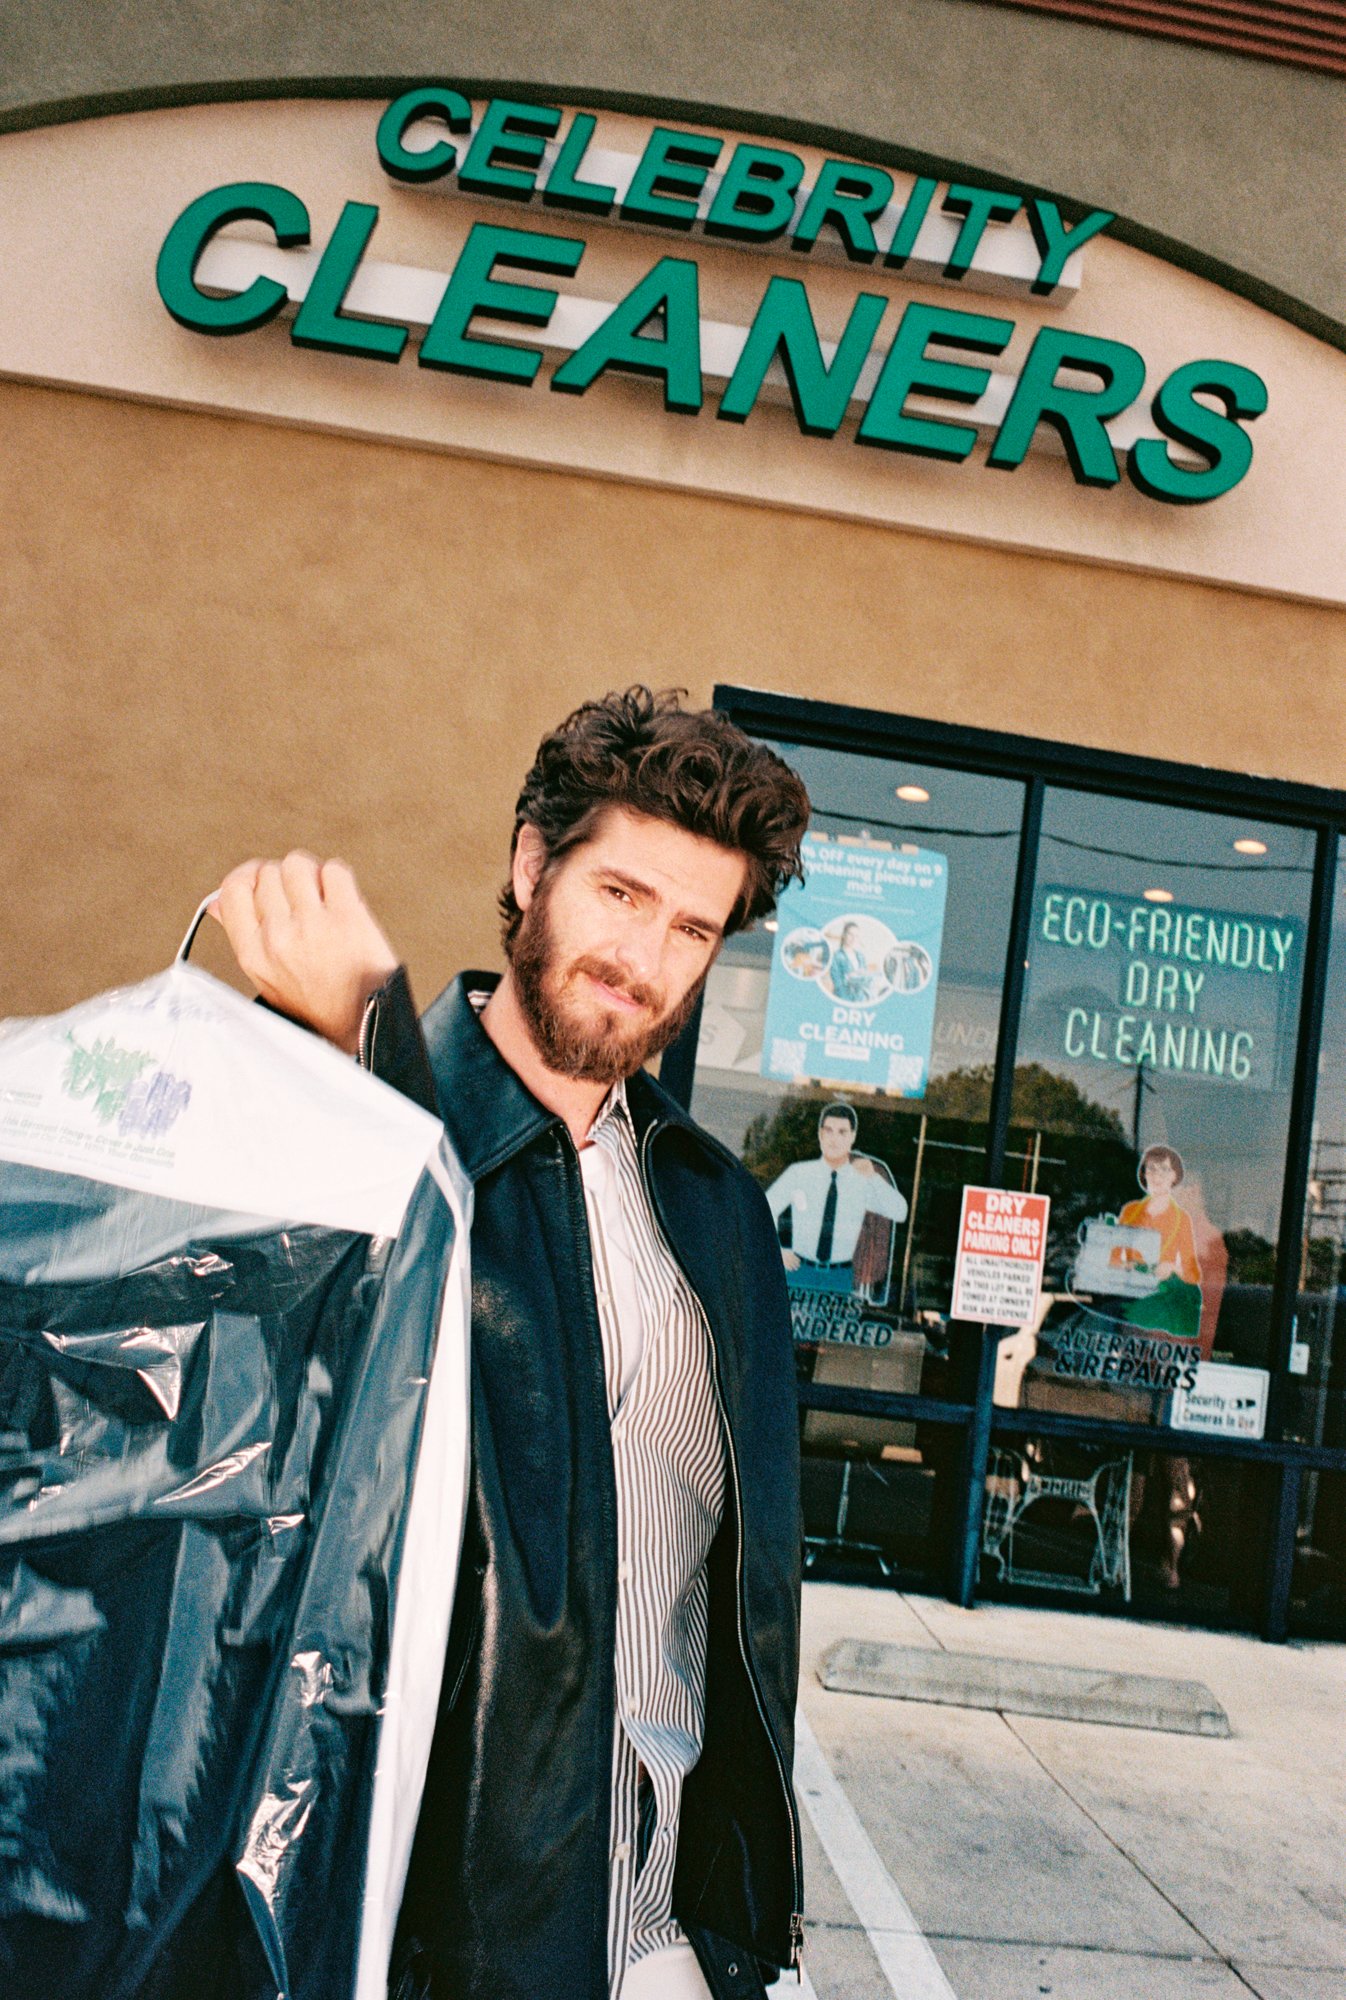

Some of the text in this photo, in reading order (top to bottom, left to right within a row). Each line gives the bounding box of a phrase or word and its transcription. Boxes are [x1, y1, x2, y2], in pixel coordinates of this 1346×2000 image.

[376, 87, 1116, 296] CELEBRITY
[156, 181, 1269, 505] CLEANERS
[819, 848, 844, 861] OFF
[847, 854, 883, 870] every
[887, 857, 911, 873] day
[914, 864, 930, 875] on
[847, 880, 882, 894] more
[1043, 894, 1293, 972] ECO-FRIENDLY
[1126, 961, 1204, 1013] DRY
[832, 1006, 877, 1027] DRY
[800, 1022, 904, 1051] CLEANING
[1065, 1008, 1253, 1080] CLEANING
[986, 1193, 1027, 1216] DRY
[967, 1210, 1040, 1238] CLEANERS
[964, 1229, 1040, 1257] PARKING ONLY
[967, 1268, 1031, 1283] VEHICLES PARKED
[980, 1257, 1035, 1272] UNAUTHORIZED
[961, 1279, 971, 1288] ON
[974, 1280, 989, 1290] THIS
[991, 1282, 1004, 1292] LOT
[1007, 1285, 1022, 1295] WILL
[962, 1291, 987, 1301] TOWED
[989, 1294, 997, 1303] AT
[791, 1289, 862, 1318] HIRTS
[981, 1306, 994, 1316] AND
[792, 1315, 892, 1346] NDERED
[1056, 1326, 1200, 1365] ALTERATIONS
[1054, 1353, 1197, 1390] & REPAIRS
[1185, 1393, 1226, 1412] Security
[1183, 1407, 1223, 1427] Cameras
[1238, 1415, 1255, 1429] Use
